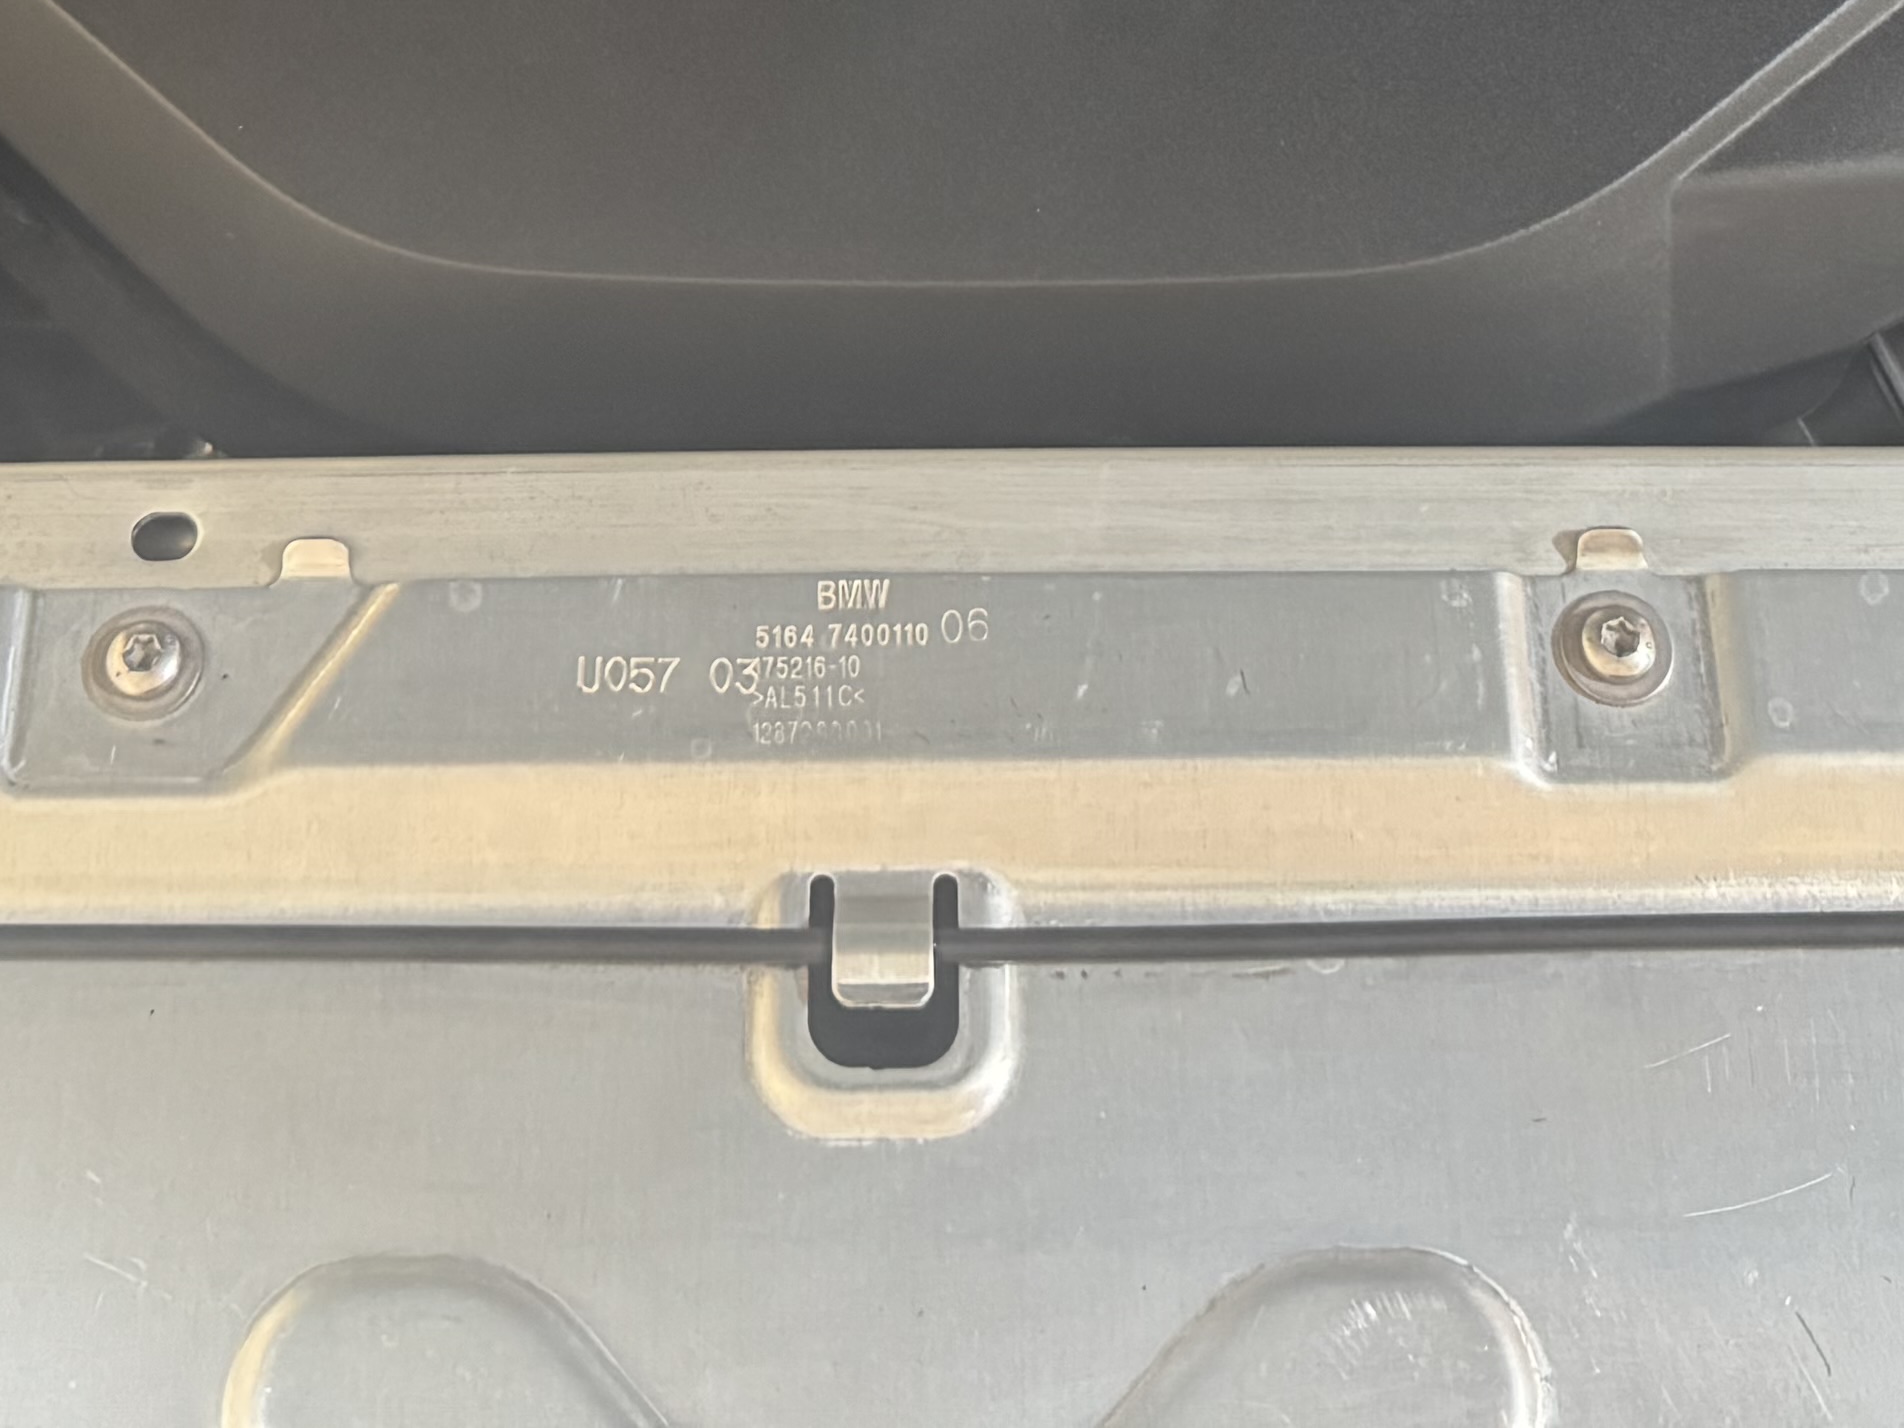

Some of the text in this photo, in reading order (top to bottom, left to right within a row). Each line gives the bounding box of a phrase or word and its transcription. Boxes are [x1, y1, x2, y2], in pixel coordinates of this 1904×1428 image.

[816, 578, 891, 612] BMW
[755, 621, 929, 649] 5164 7400110
[940, 607, 989, 644] 06
[708, 655, 760, 695] 03
